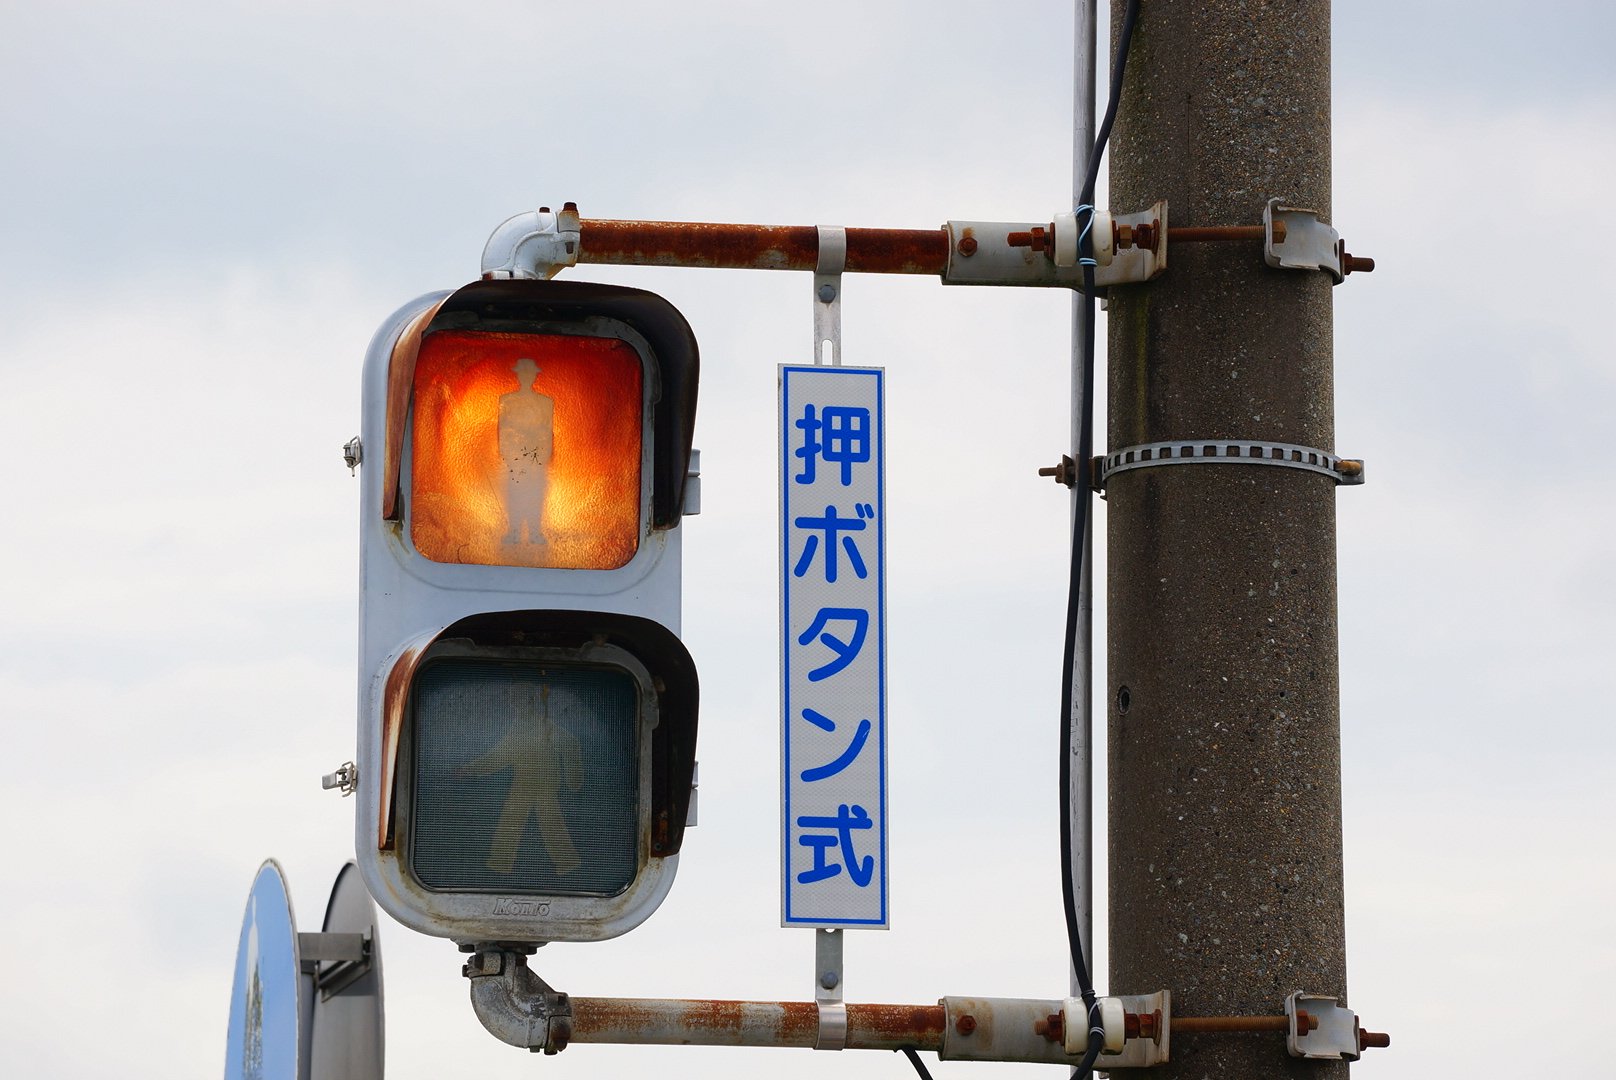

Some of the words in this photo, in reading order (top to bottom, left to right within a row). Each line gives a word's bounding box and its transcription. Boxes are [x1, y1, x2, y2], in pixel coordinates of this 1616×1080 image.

[794, 403, 875, 888] 押ボタン式
